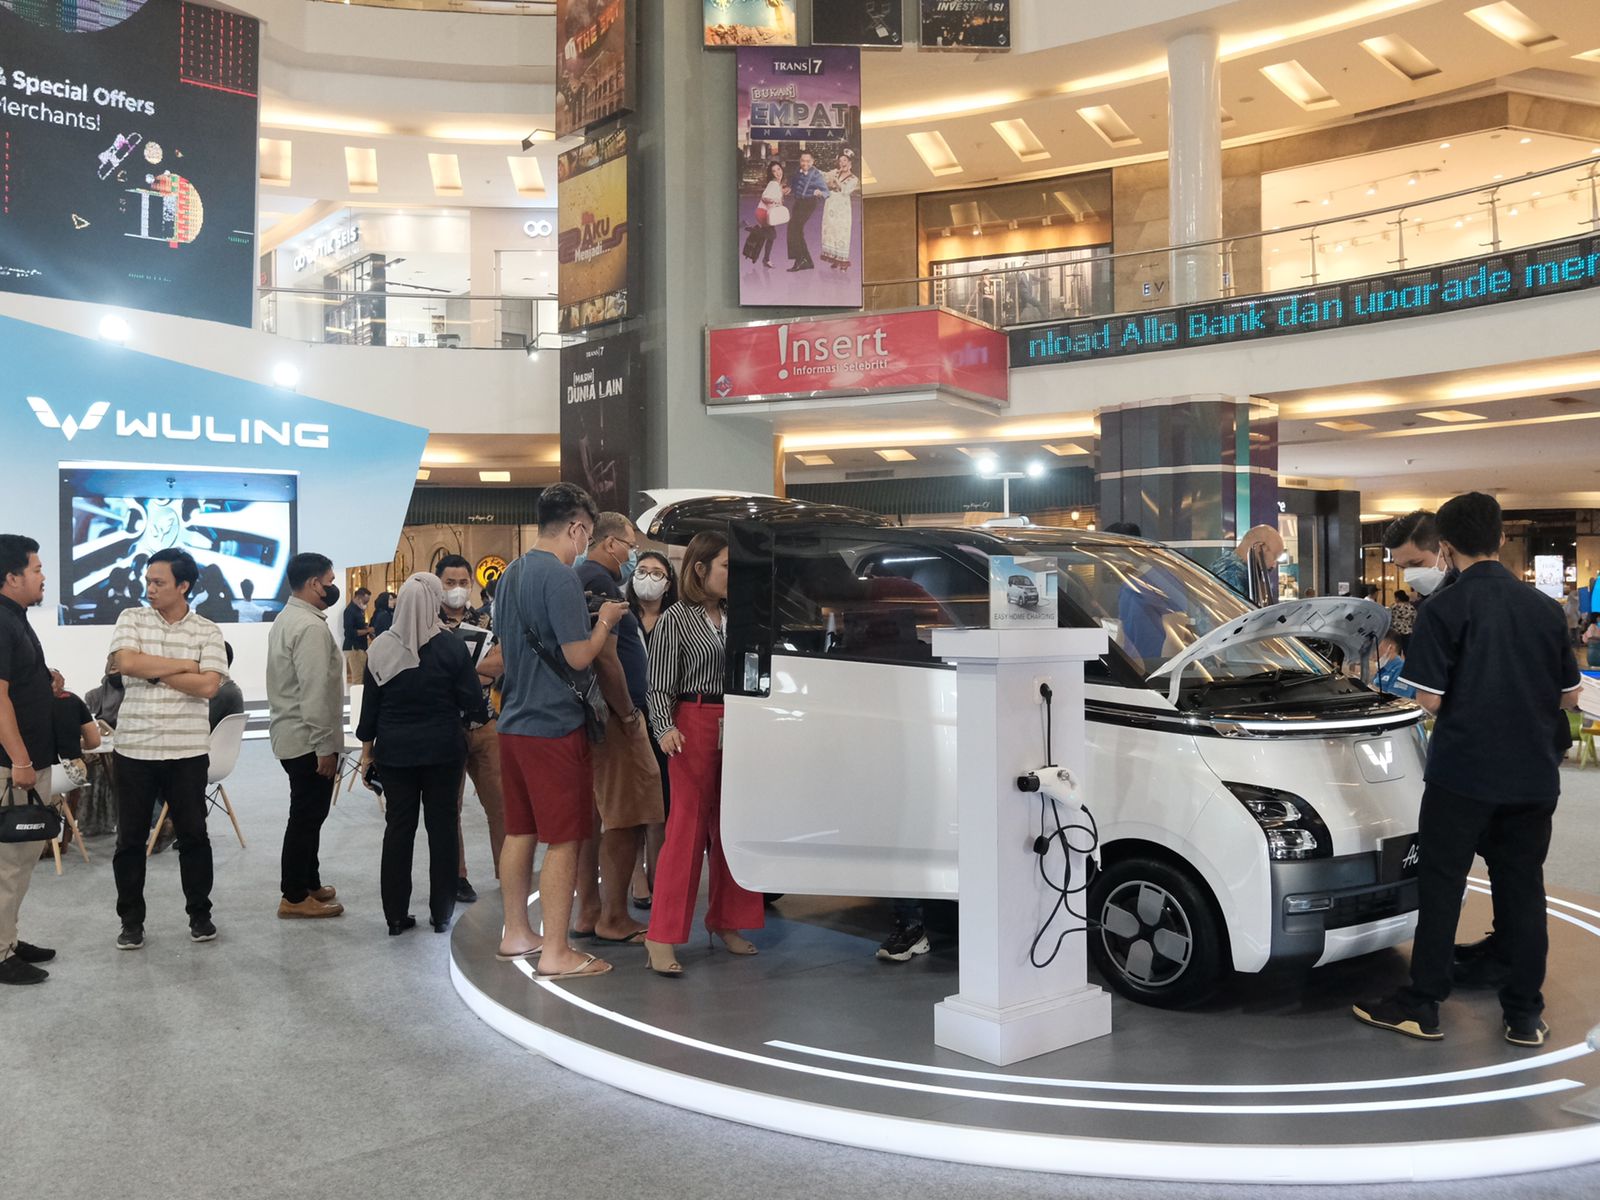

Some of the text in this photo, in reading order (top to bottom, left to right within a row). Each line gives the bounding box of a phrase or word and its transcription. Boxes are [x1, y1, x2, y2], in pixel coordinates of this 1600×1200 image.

[937, 2, 1005, 11] INVESTIASI
[12, 70, 88, 102] Special
[93, 87, 155, 116] Offers
[751, 101, 849, 127] EMPAT
[1029, 323, 1110, 358] nload
[1121, 317, 1178, 347] Allo
[1188, 303, 1266, 339] Bank
[1277, 295, 1343, 327] dan
[793, 359, 889, 377] Informasi Selebriti
[567, 376, 624, 405] DUNIA LAIN
[115, 409, 329, 449] WULING
[994, 612, 1055, 621] EASY HOME CHARGING
